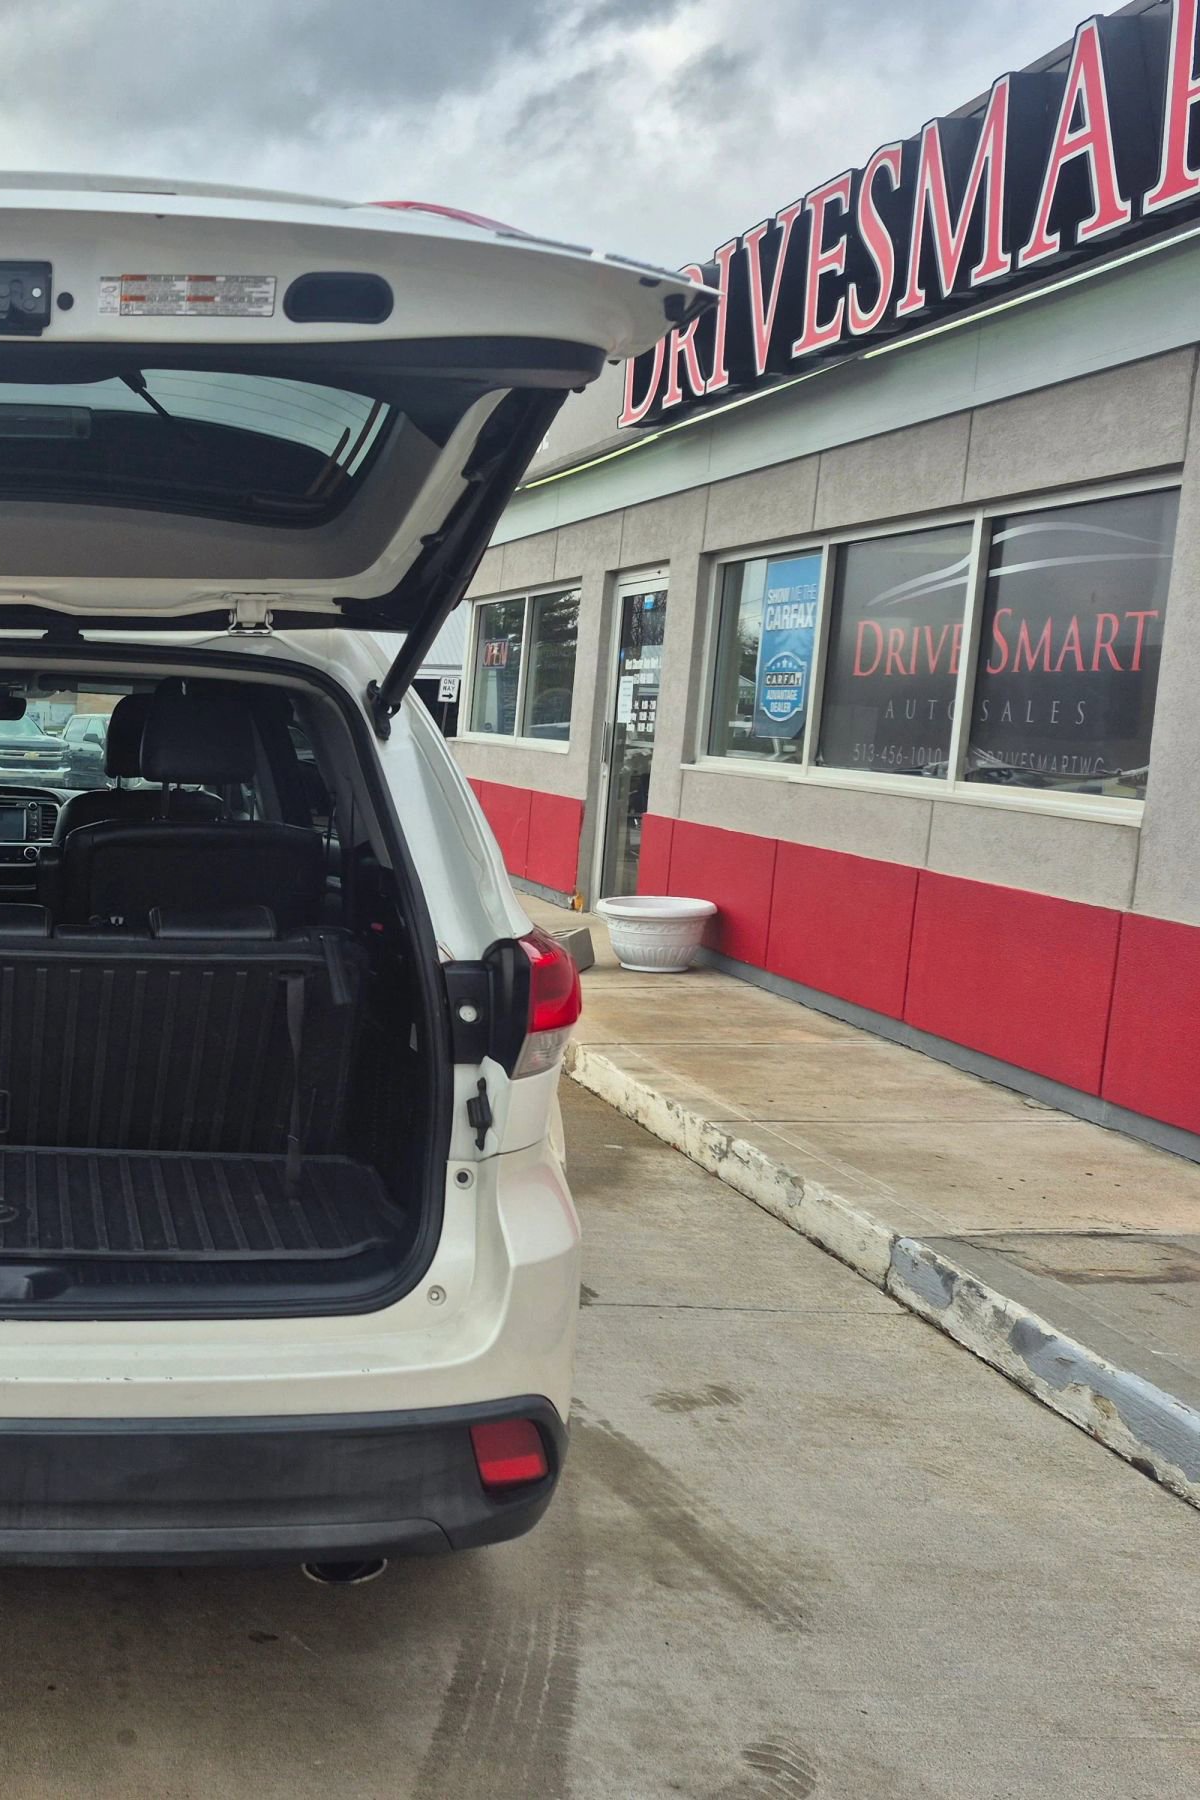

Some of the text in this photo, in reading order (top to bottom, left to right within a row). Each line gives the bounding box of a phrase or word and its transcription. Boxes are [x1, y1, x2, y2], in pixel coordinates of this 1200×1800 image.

[766, 602, 817, 630] CARFAX
[985, 608, 1159, 675] SMART
[484, 642, 508, 666] OPEN
[766, 690, 798, 700] ADVANTAGE
[770, 702, 791, 712] DEALER
[980, 700, 1087, 725] SALES
[853, 743, 942, 765] 513-456-1010
